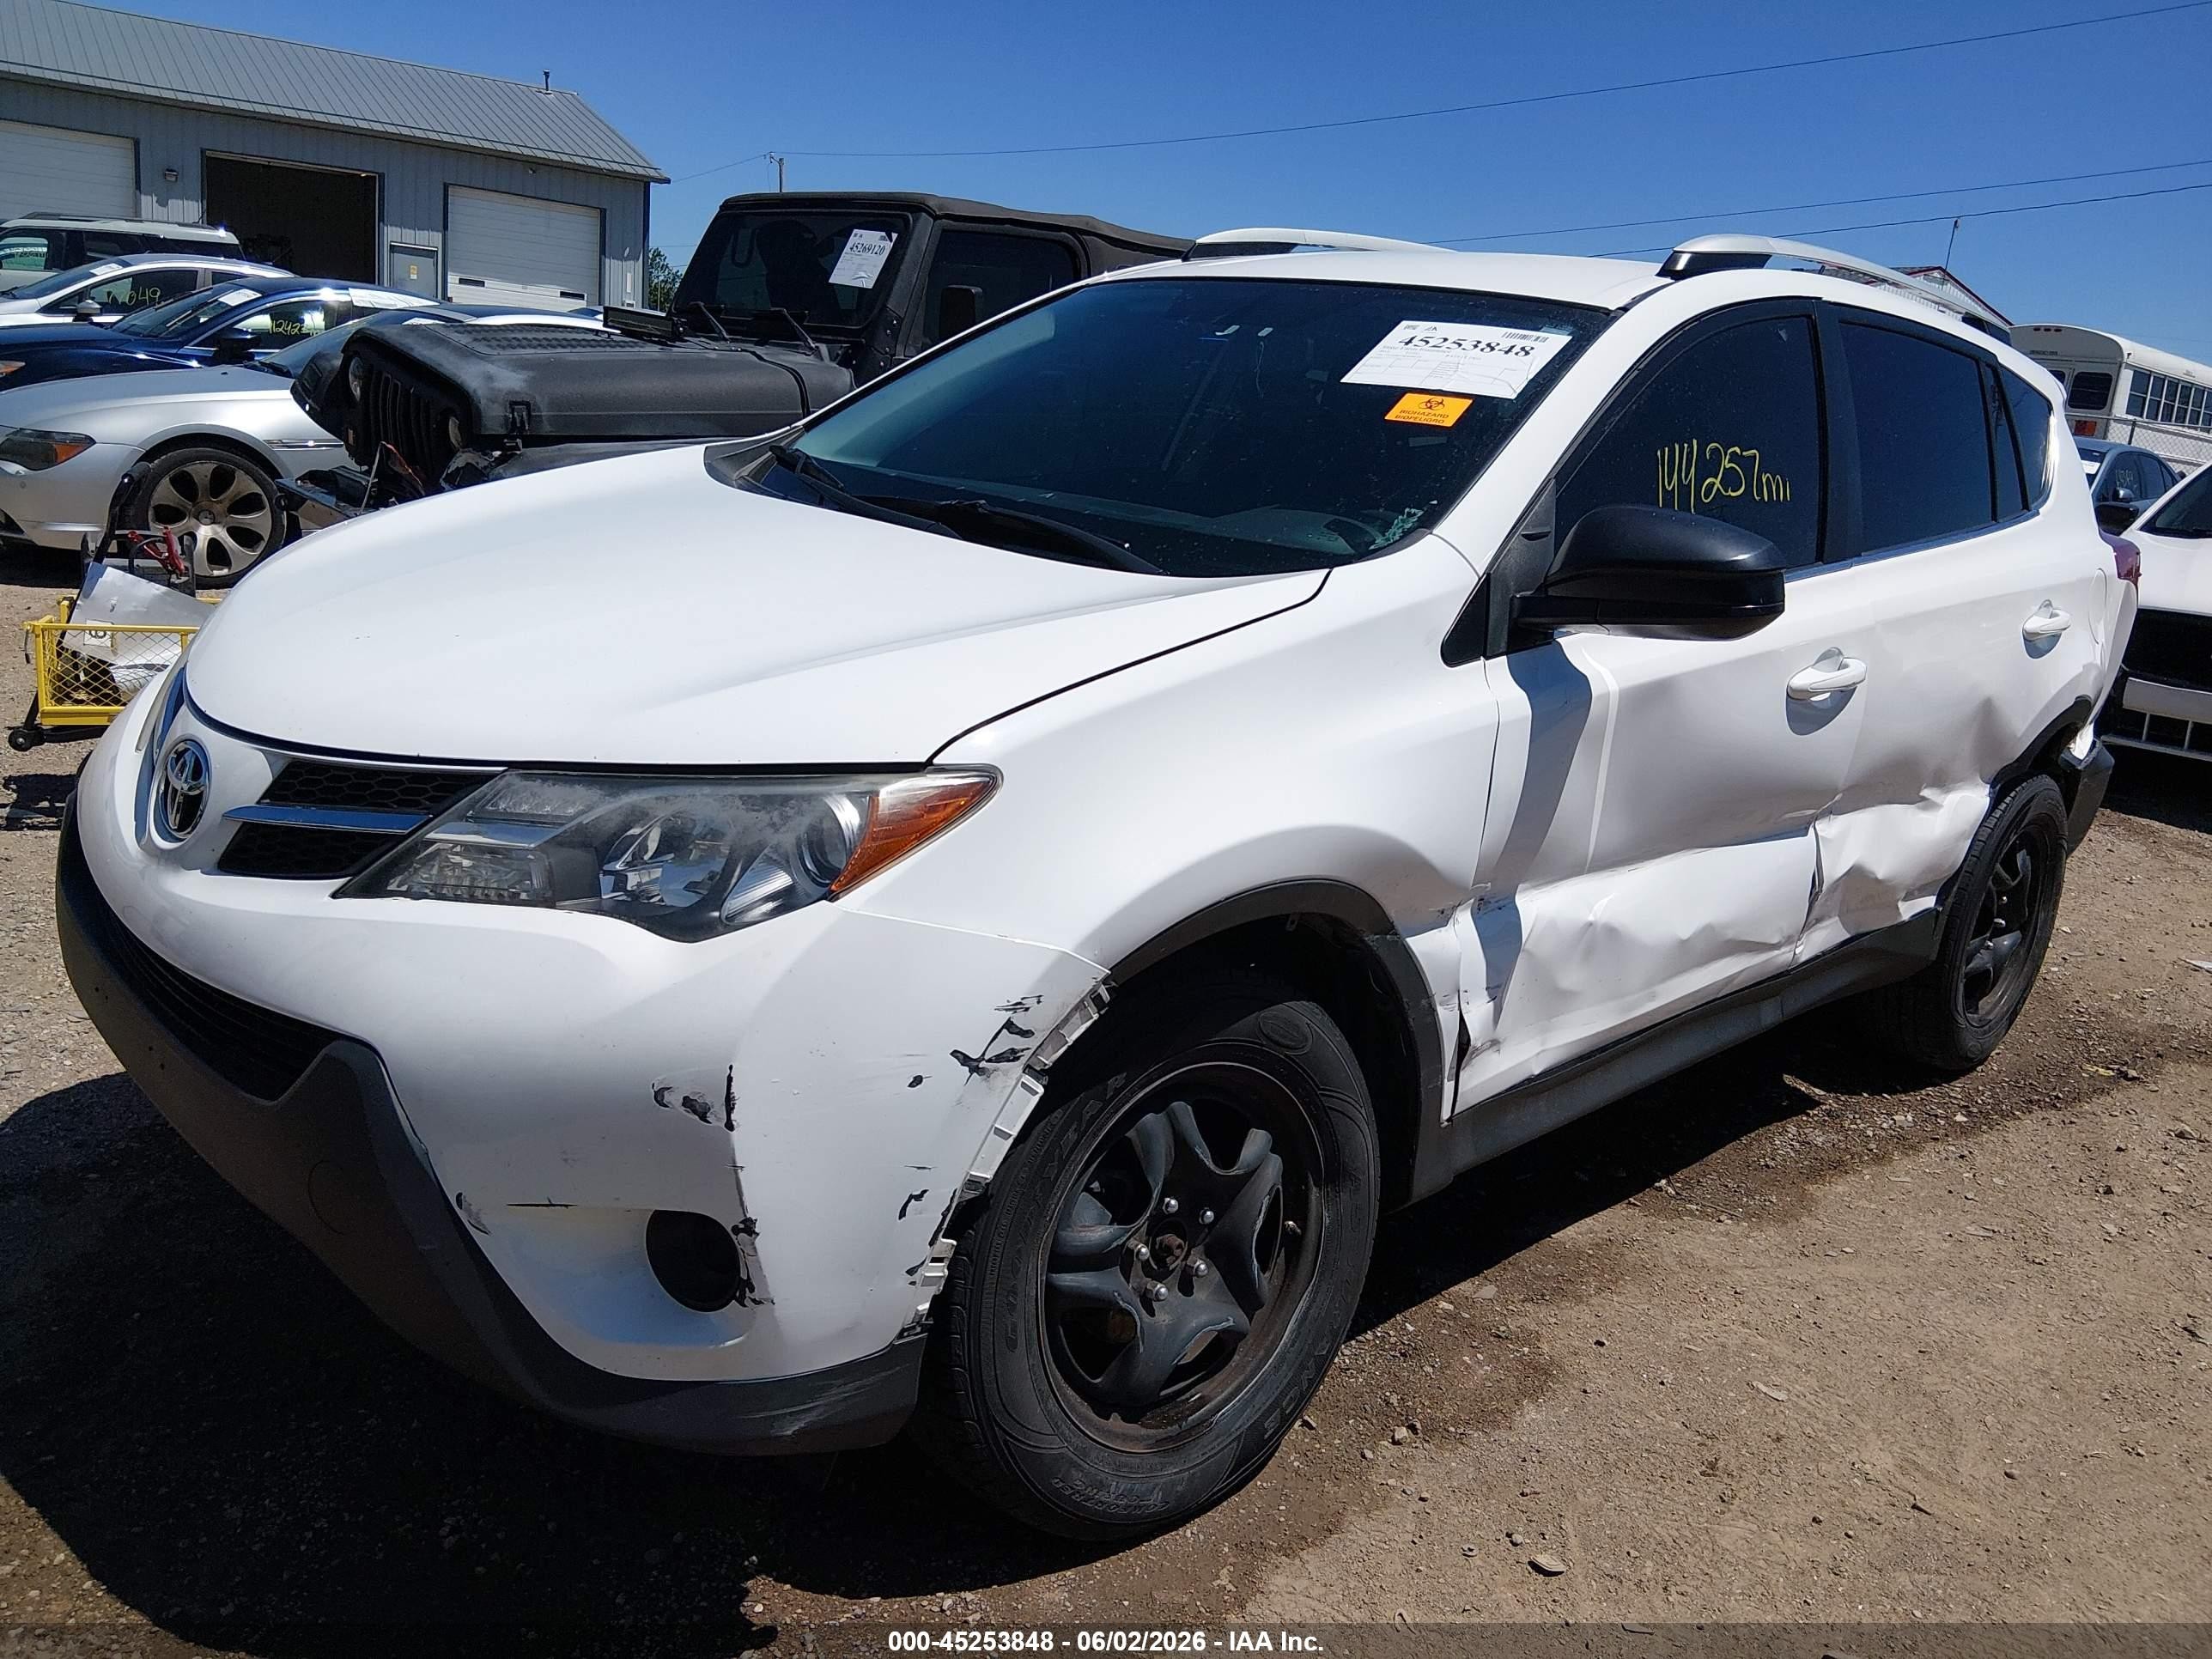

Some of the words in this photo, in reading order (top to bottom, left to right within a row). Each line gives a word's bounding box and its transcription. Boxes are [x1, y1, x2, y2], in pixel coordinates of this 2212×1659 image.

[849, 242, 886, 256] 45269120
[1398, 335, 1535, 357] 45253848
[1395, 414, 1445, 424] BIOPELIGRO
[1400, 410, 1449, 419] BIOHAZARD
